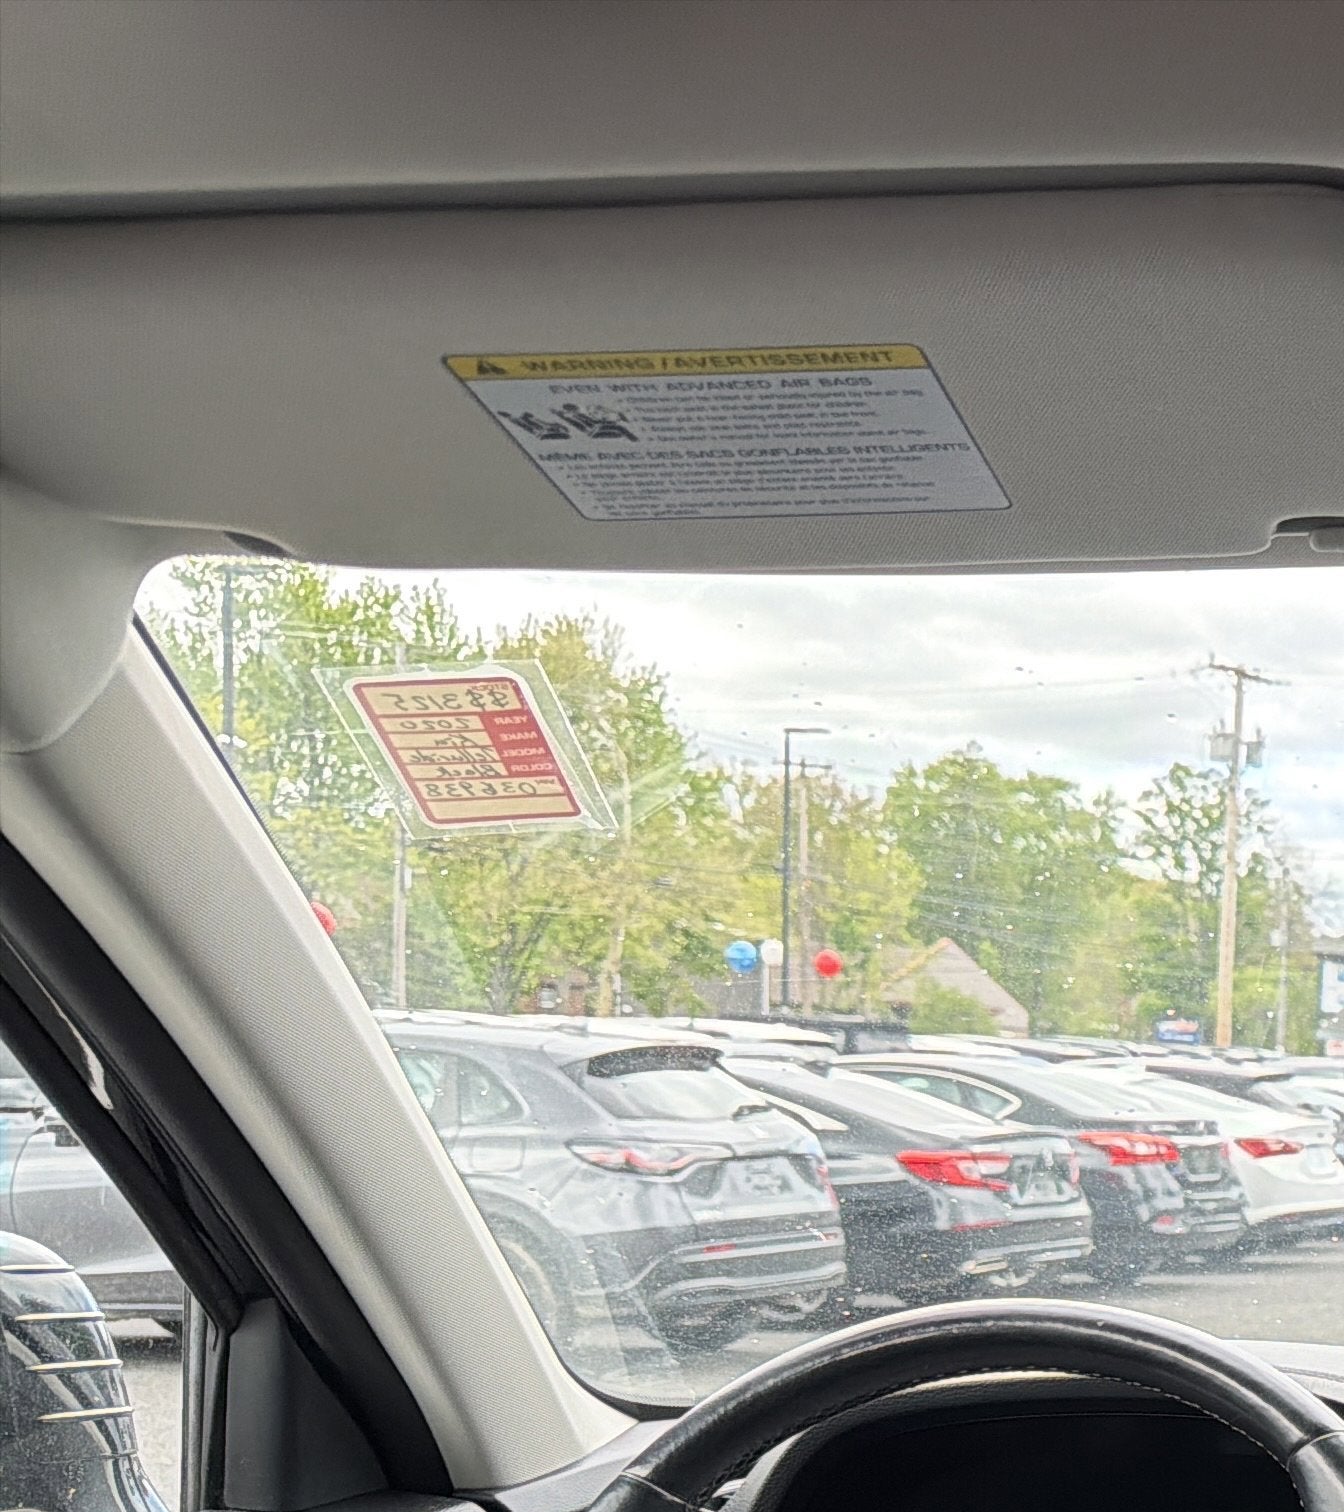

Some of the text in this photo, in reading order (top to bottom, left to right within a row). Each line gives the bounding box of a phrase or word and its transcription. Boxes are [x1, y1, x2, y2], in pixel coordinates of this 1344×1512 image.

[521, 357, 654, 373] WARNING
[667, 379, 772, 392] ADVANCED
[781, 378, 810, 389] AIR
[818, 377, 873, 388] BAGS
